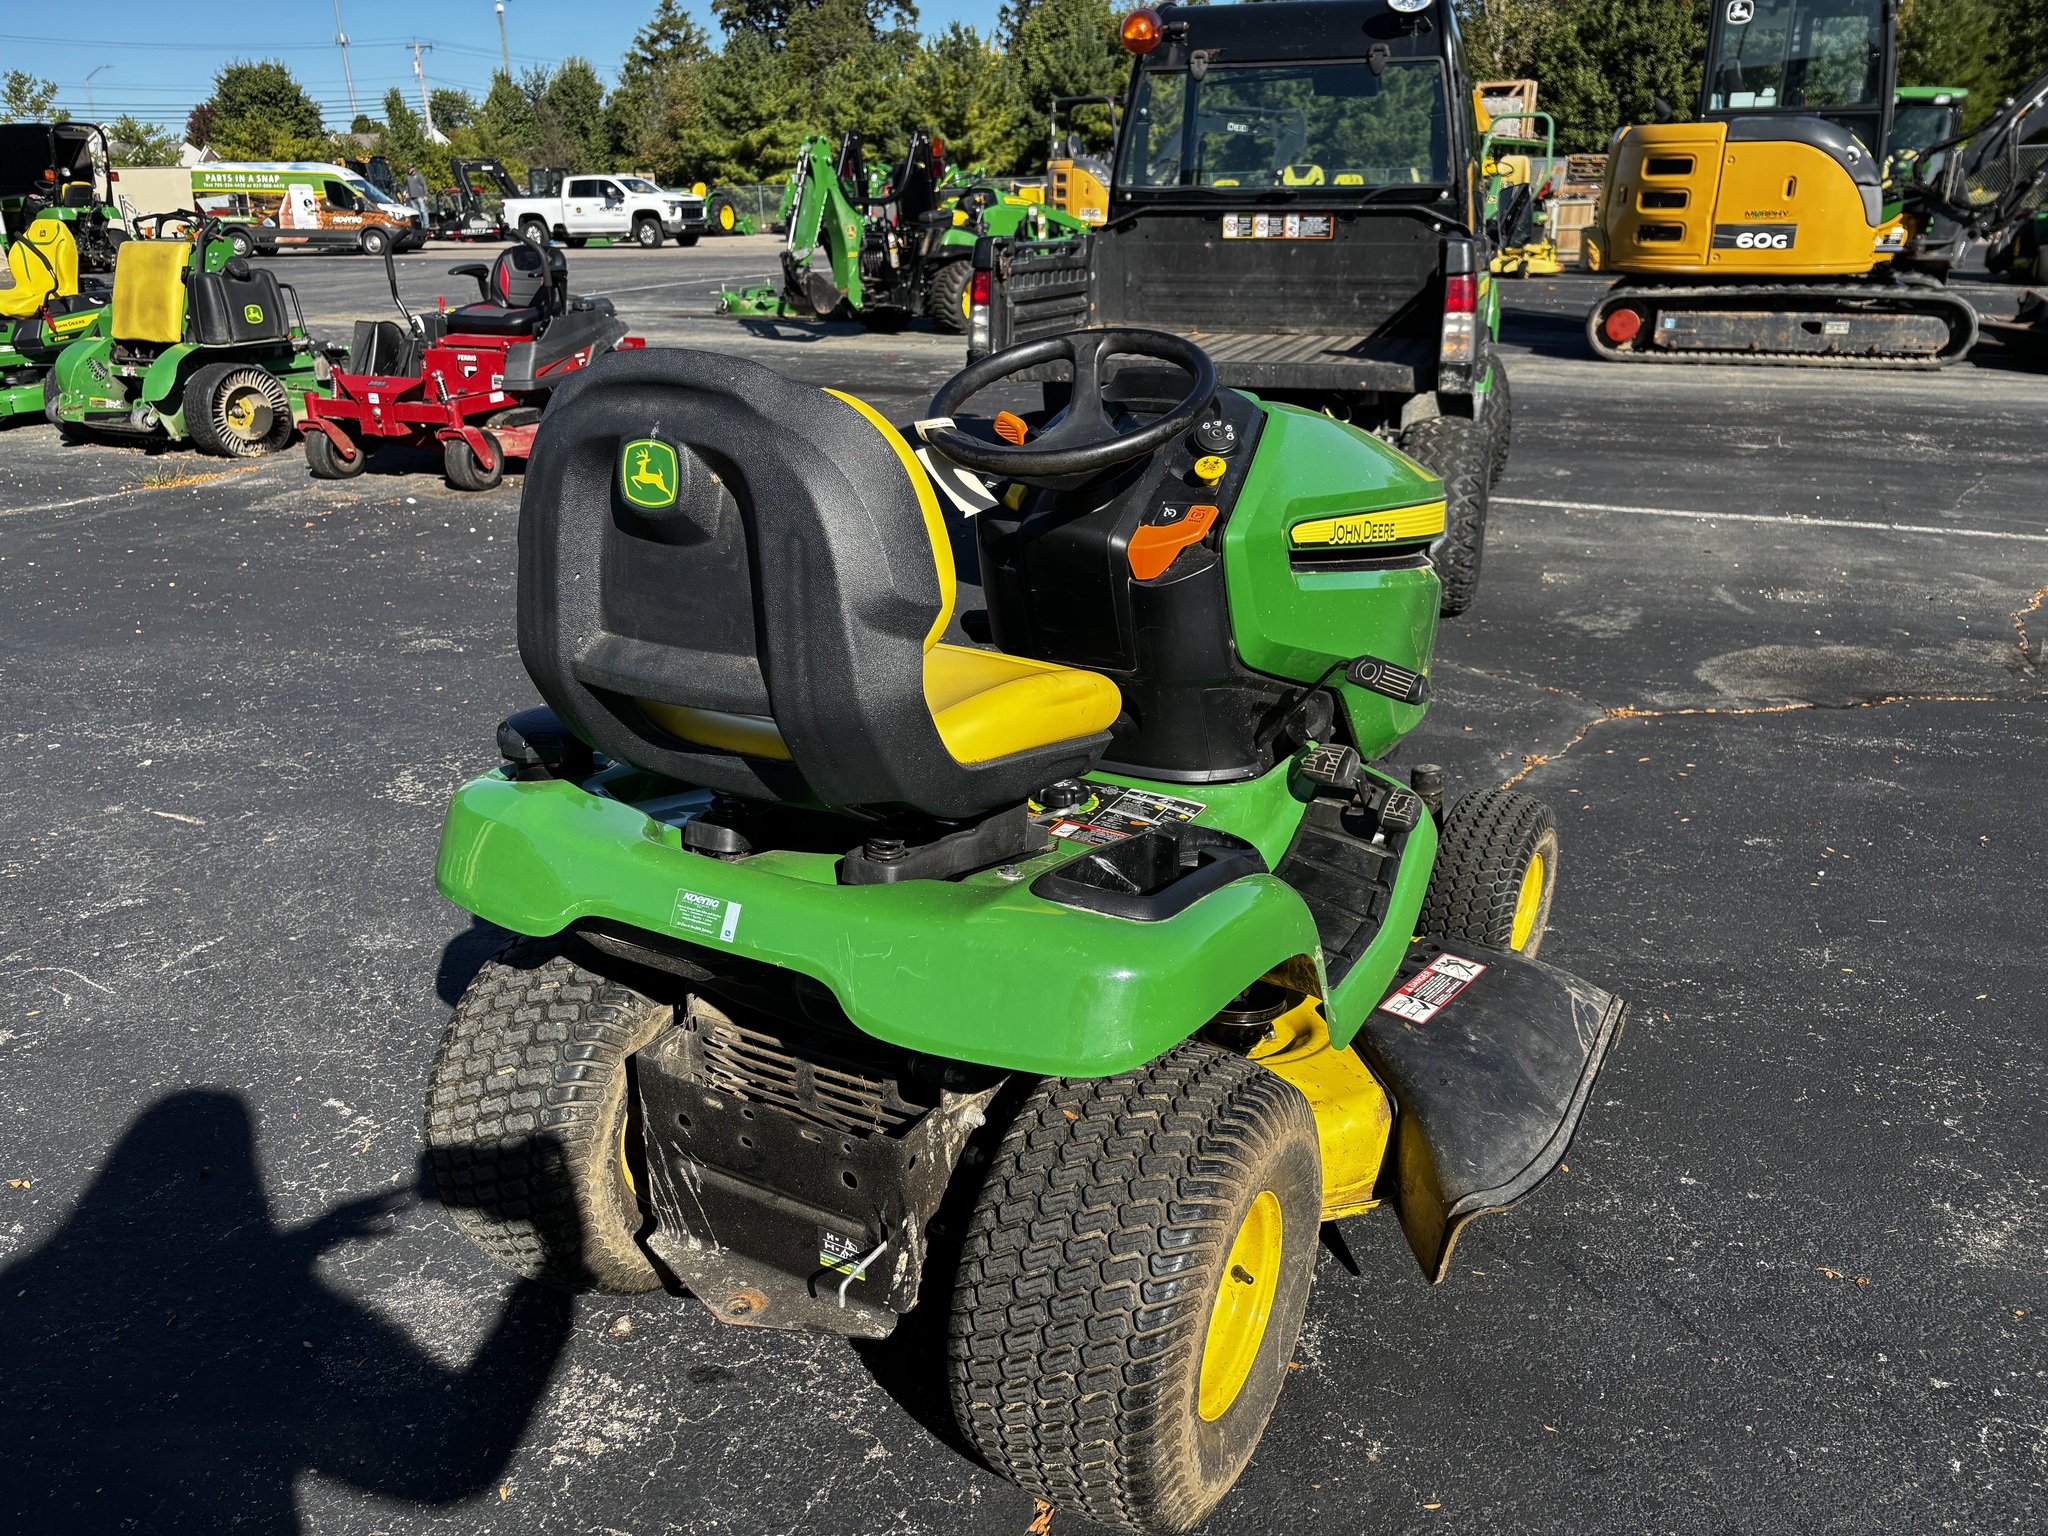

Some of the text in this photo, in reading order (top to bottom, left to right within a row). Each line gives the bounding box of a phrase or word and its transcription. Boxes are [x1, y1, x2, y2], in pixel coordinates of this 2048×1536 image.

[205, 174, 233, 182] PARTS
[256, 175, 280, 183] SNAP
[1736, 232, 1787, 248] 60G
[1329, 520, 1395, 541] JOHN DEERE
[1409, 970, 1432, 988] DANGER
